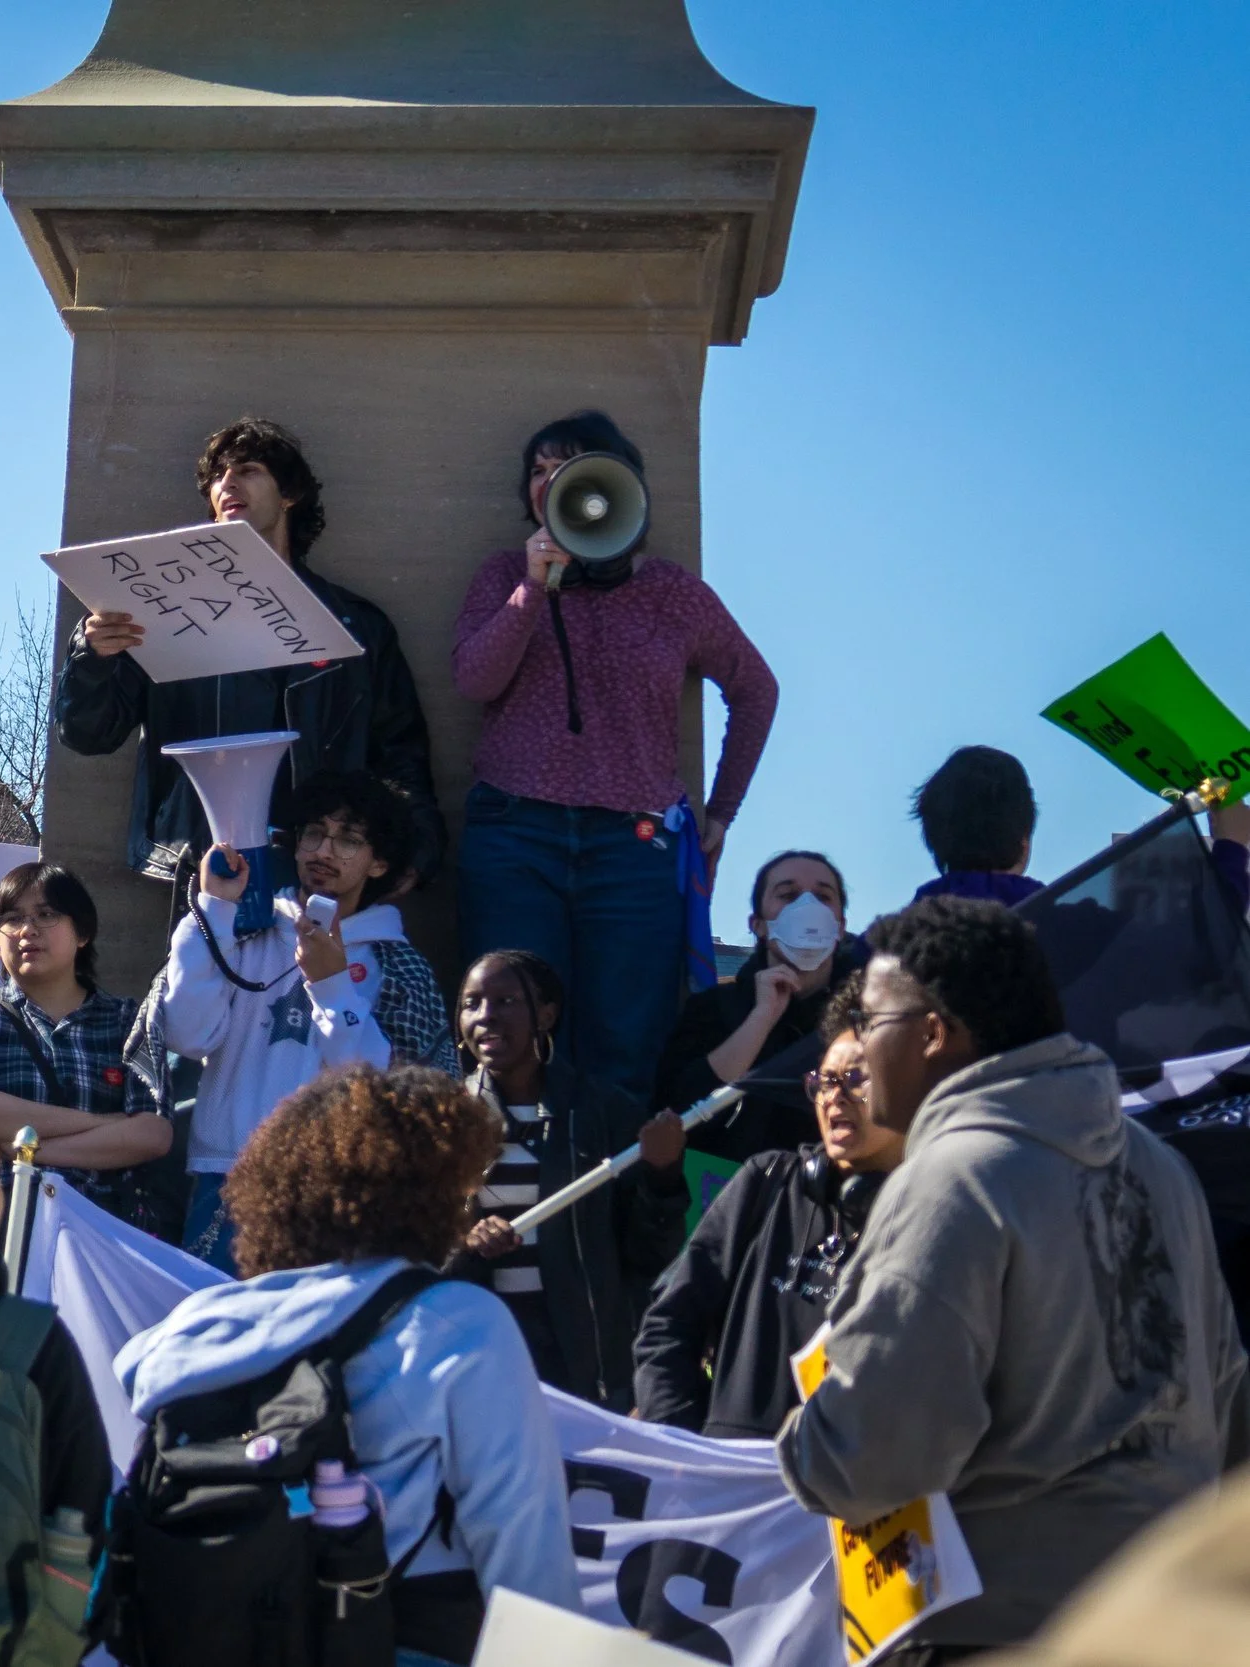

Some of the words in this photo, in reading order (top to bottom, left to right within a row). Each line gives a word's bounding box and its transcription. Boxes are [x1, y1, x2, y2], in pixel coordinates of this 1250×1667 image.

[101, 551, 208, 637] RIGHT
[155, 559, 196, 585] IS
[190, 597, 232, 621] A
[181, 534, 326, 656] EDUCATION
